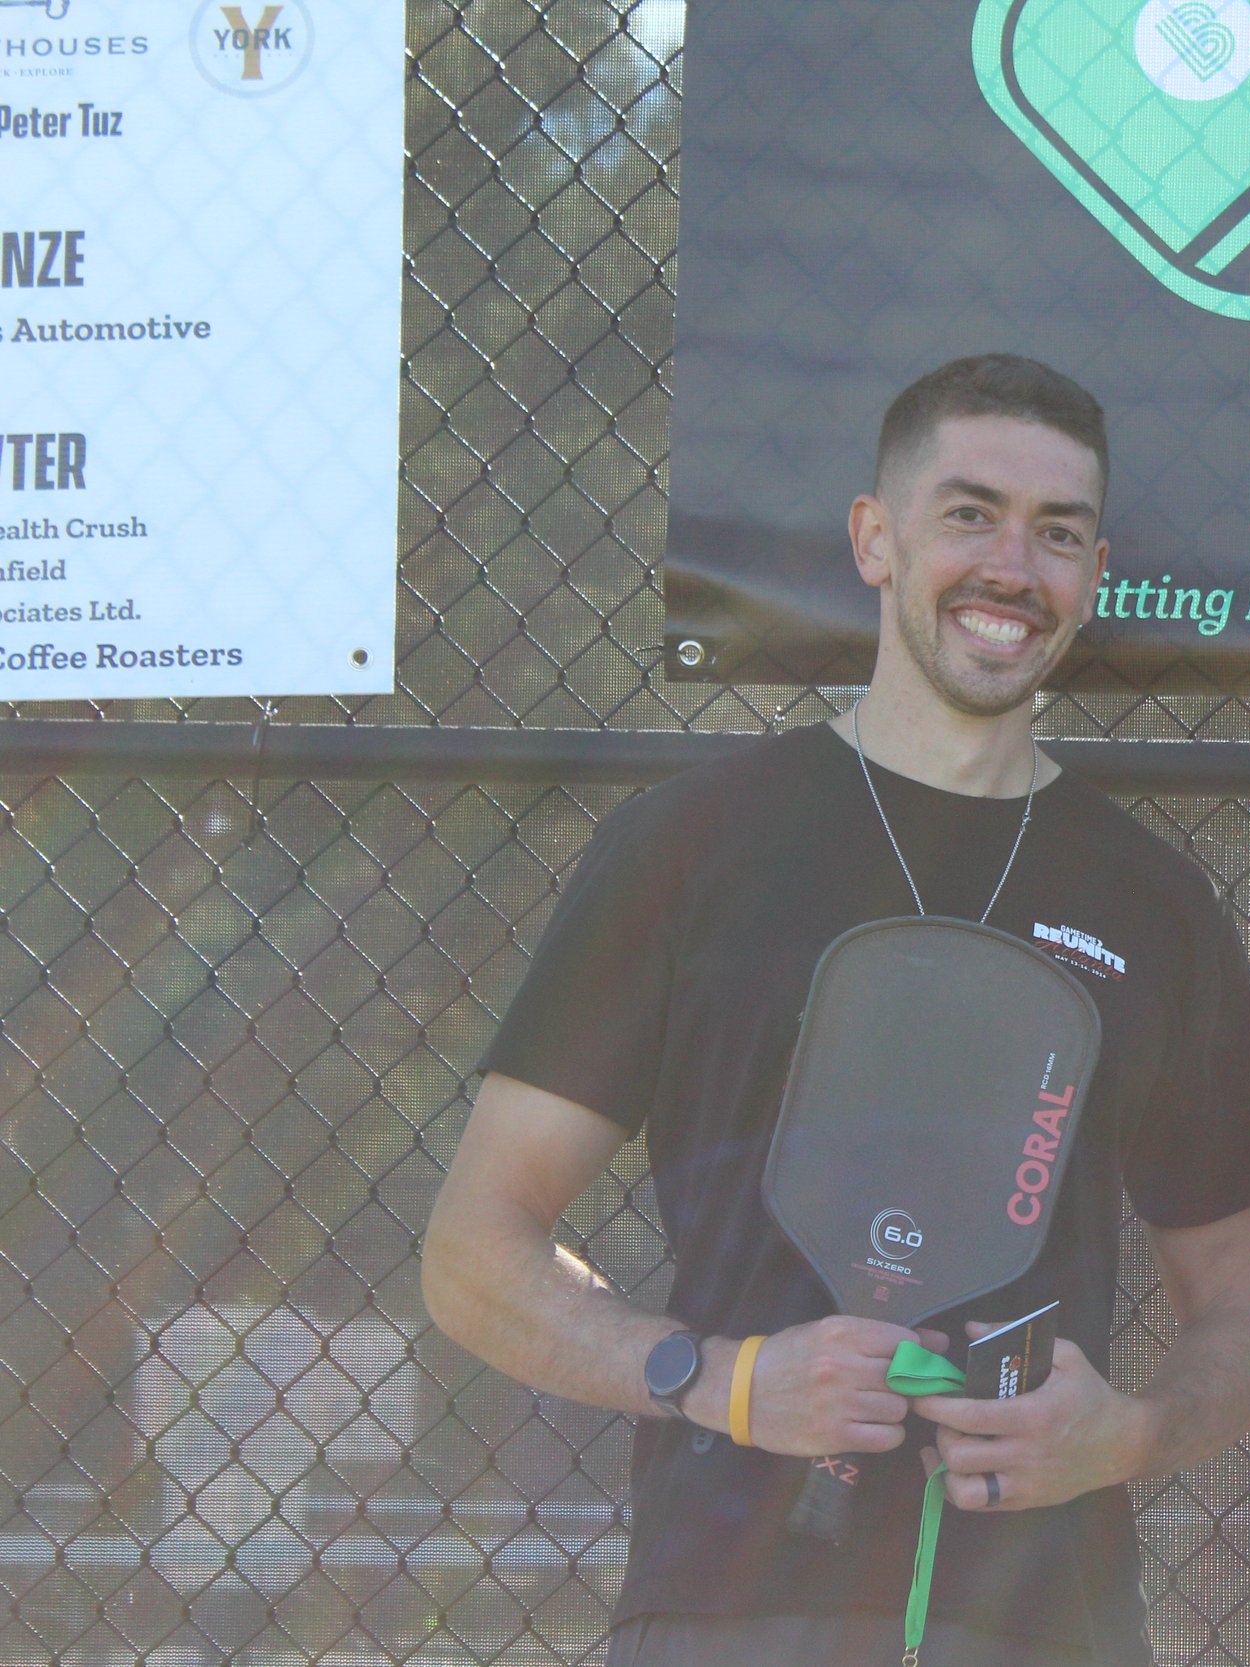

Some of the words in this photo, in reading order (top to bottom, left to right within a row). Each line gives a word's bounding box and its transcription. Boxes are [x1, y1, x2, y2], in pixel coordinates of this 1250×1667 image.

[213, 28, 292, 51] YORK
[20, 67, 73, 77] EXPLORE
[0, 104, 72, 139] Peter
[78, 102, 123, 137] Tuz
[1, 230, 85, 289] NZE
[11, 314, 211, 342] Automotive
[0, 432, 87, 491] TER
[66, 516, 148, 538] Crush
[89, 598, 141, 621] Ltd.
[1096, 571, 1234, 636] itting
[96, 642, 243, 669] Roasters
[1032, 922, 1126, 973] REUNITE
[1061, 924, 1098, 945] GAMETIME
[1007, 1084, 1075, 1226] CORAL
[884, 1226, 923, 1248] 6.0
